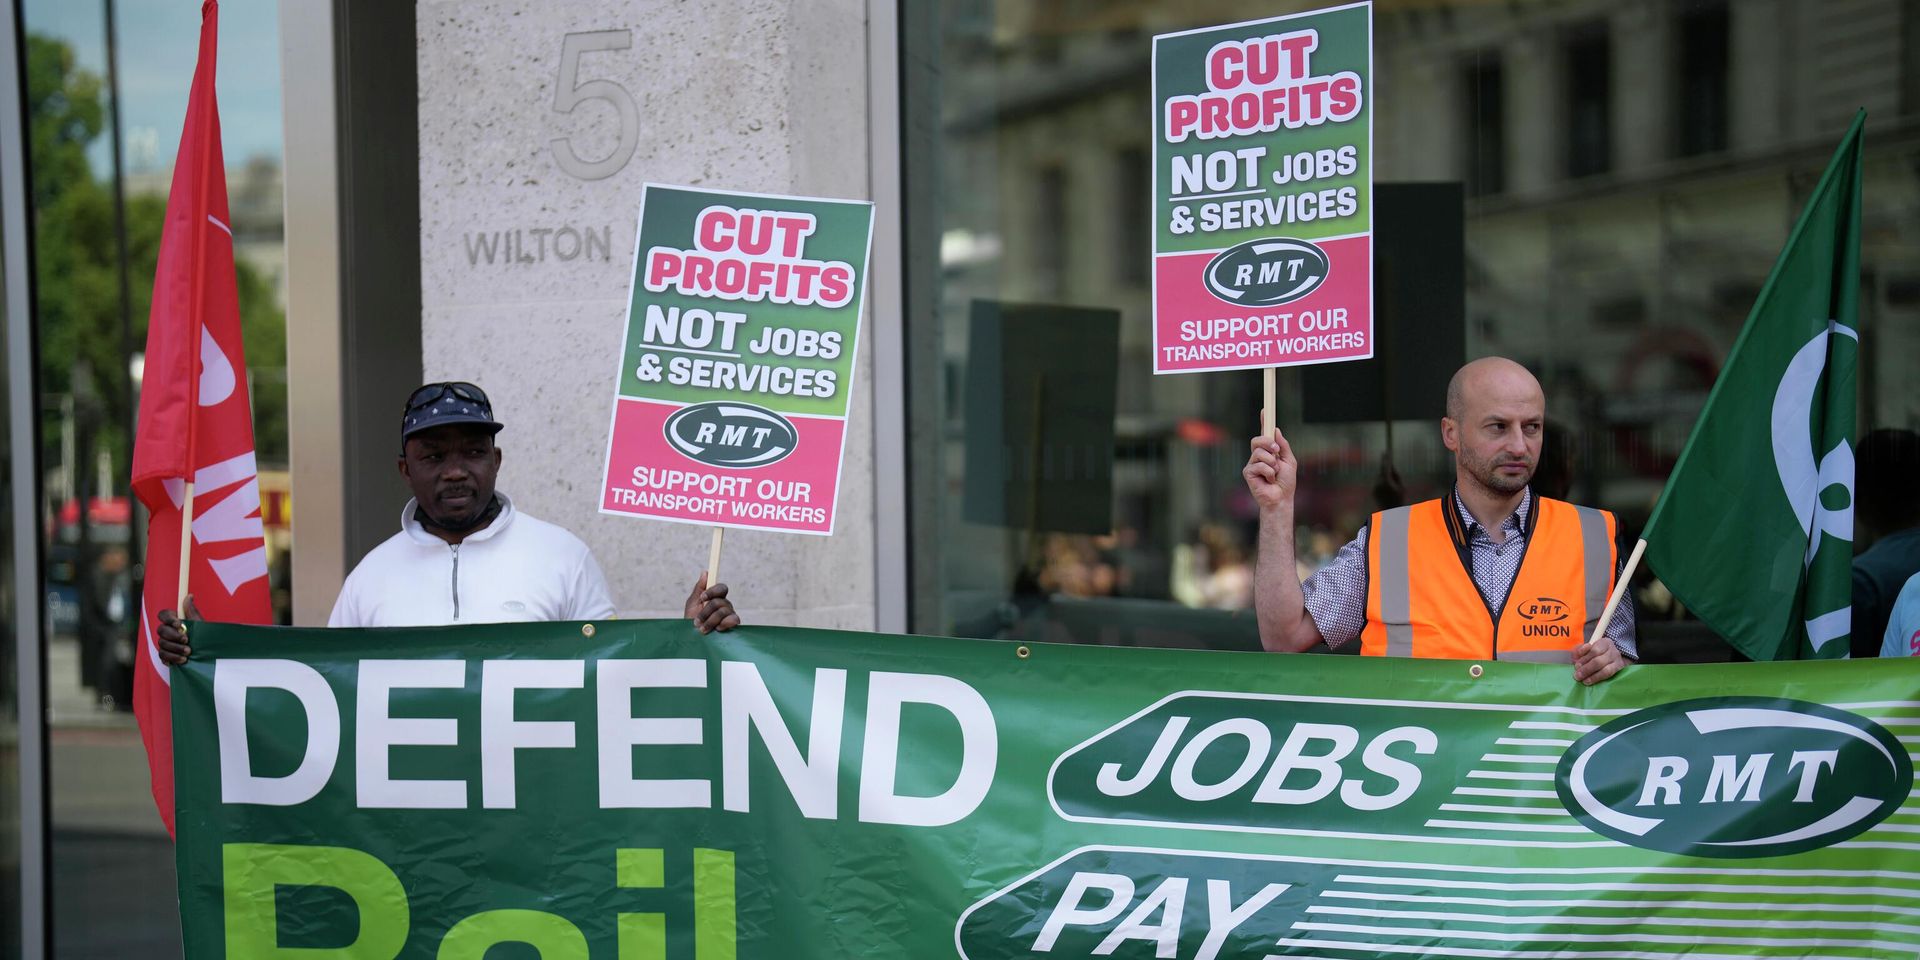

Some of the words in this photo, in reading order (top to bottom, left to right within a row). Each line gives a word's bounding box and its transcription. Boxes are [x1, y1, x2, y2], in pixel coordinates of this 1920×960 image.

[1206, 30, 1318, 92] CUT
[550, 29, 640, 181] 5
[1166, 73, 1361, 142] PROFITS
[1171, 146, 1266, 195] NOT
[1272, 145, 1357, 185] JOBS
[694, 206, 817, 259] CUT
[1169, 205, 1195, 235] &
[1199, 186, 1357, 232] SERVICES
[464, 225, 611, 266] WILTON
[644, 247, 855, 308] PROFITS
[1234, 258, 1304, 287] RMT
[642, 304, 747, 351] NOT
[749, 326, 842, 360] JOBS
[1163, 340, 1273, 363] TRANSPORT
[1276, 331, 1365, 355] WORKERS
[1180, 313, 1293, 342] SUPPORT
[1298, 307, 1348, 332] OUR
[636, 353, 663, 384] &
[667, 356, 838, 398] SERVICES
[694, 422, 772, 449] RMT
[611, 487, 727, 515] TRANSPORT
[730, 500, 826, 525] WORKERS
[631, 466, 752, 499] SUPPORT
[757, 479, 812, 503] OUR
[1522, 624, 1570, 638] UNION
[1529, 604, 1562, 616] RMT
[213, 658, 999, 827] DEFEND
[1096, 715, 1439, 811] JOBS
[1635, 749, 1839, 807] RMT
[1031, 871, 1292, 960] PAY
